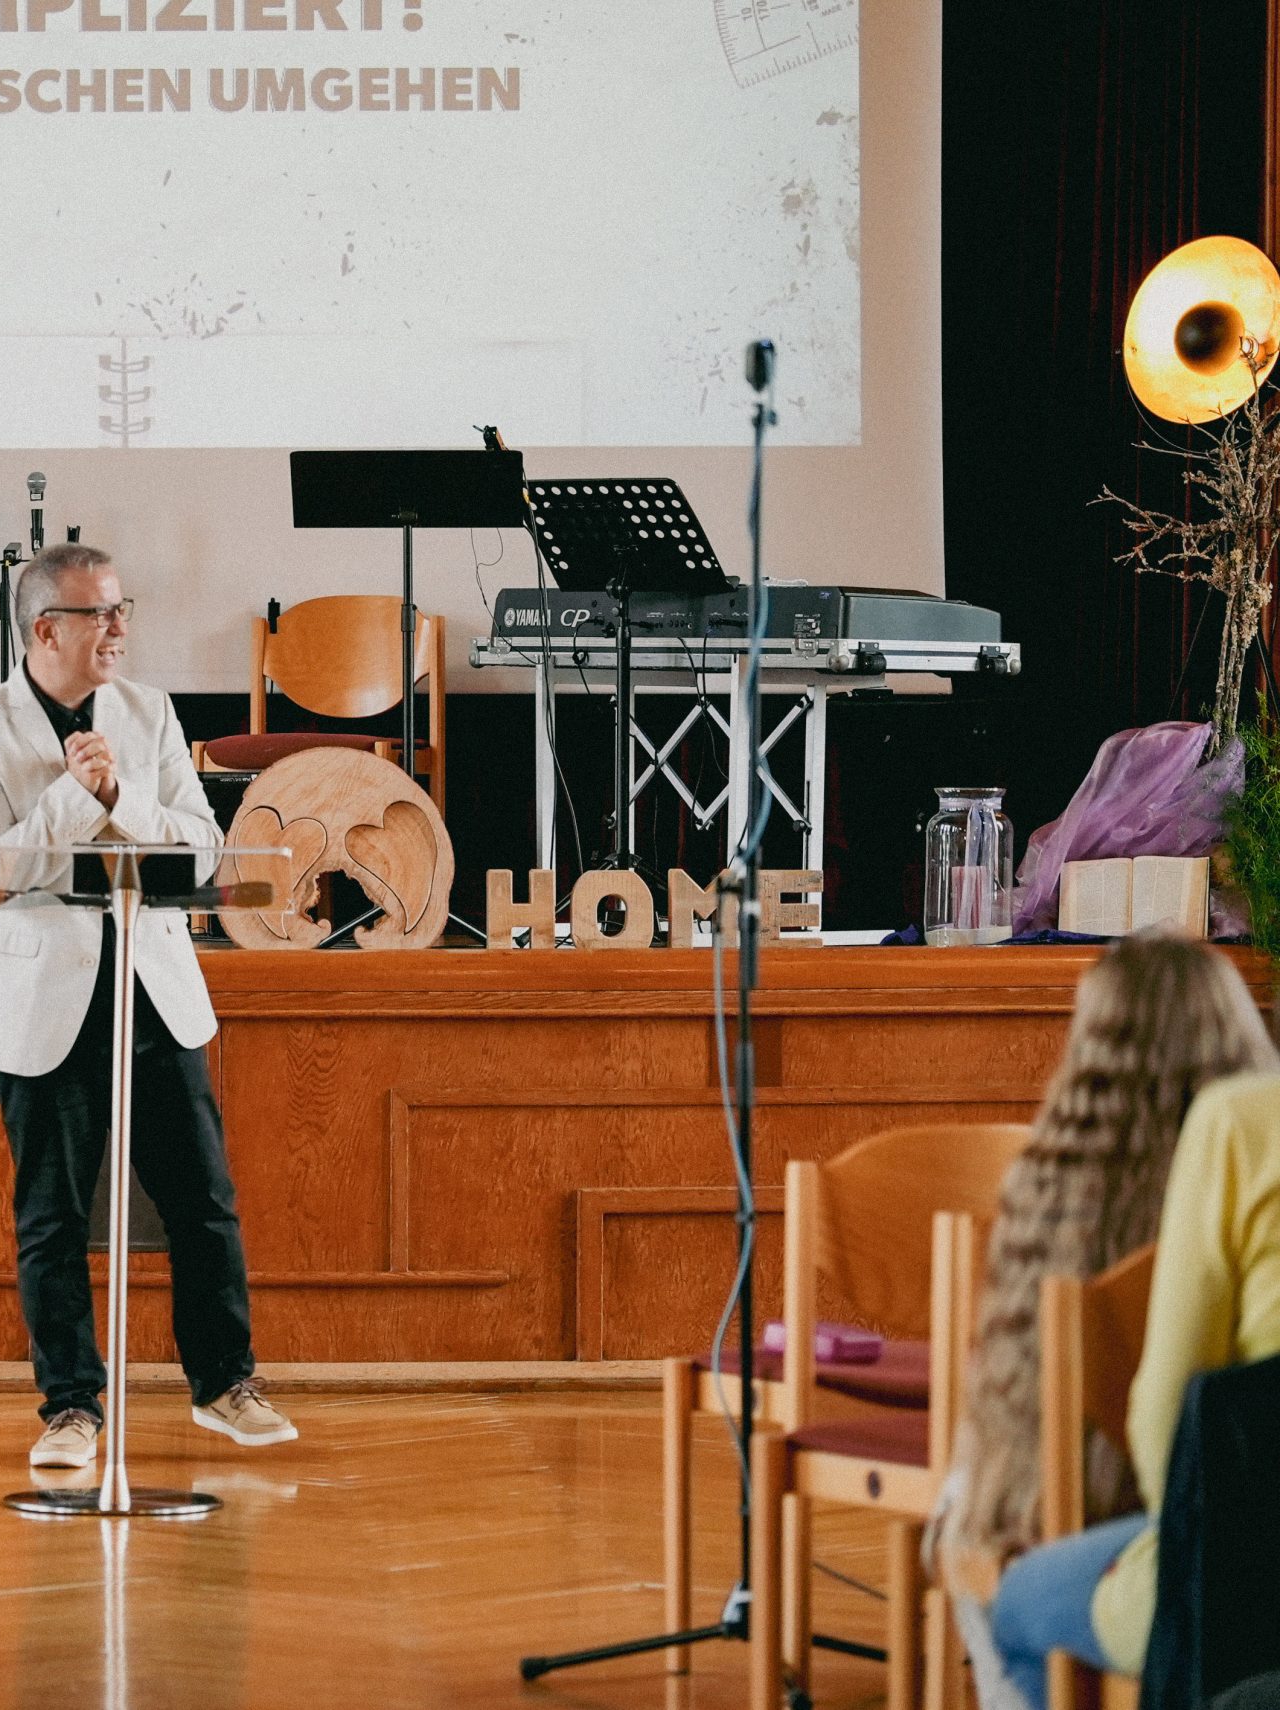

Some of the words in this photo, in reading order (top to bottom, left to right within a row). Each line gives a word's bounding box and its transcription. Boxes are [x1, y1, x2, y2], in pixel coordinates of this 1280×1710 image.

[208, 67, 521, 112] UMGEHEN
[560, 609, 590, 628] CP
[486, 868, 823, 948] HOME
